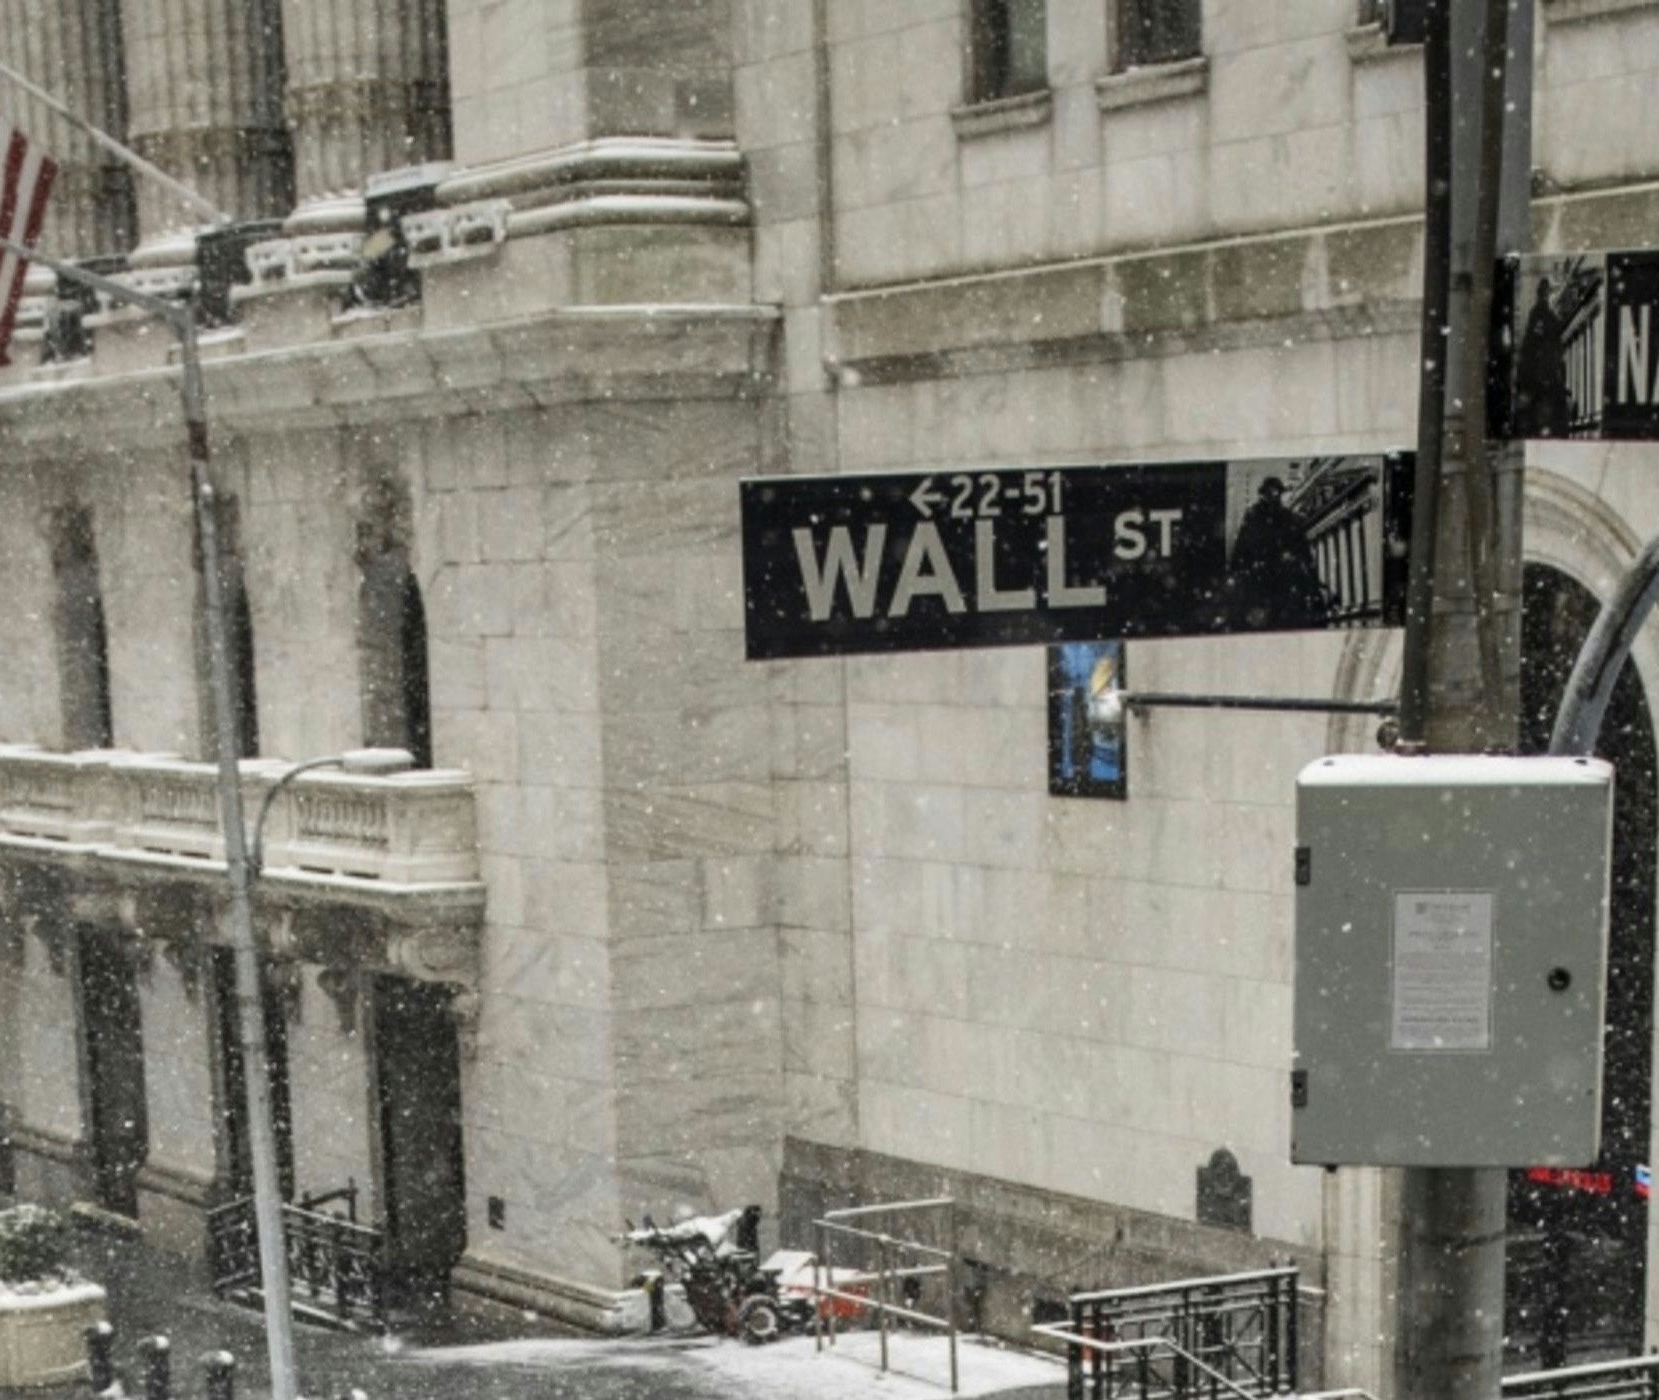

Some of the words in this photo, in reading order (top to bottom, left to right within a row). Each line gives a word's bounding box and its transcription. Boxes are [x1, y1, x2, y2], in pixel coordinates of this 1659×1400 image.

[950, 470, 1063, 518] 22-51
[792, 514, 1107, 622] WALL
[1113, 509, 1183, 560] ST
